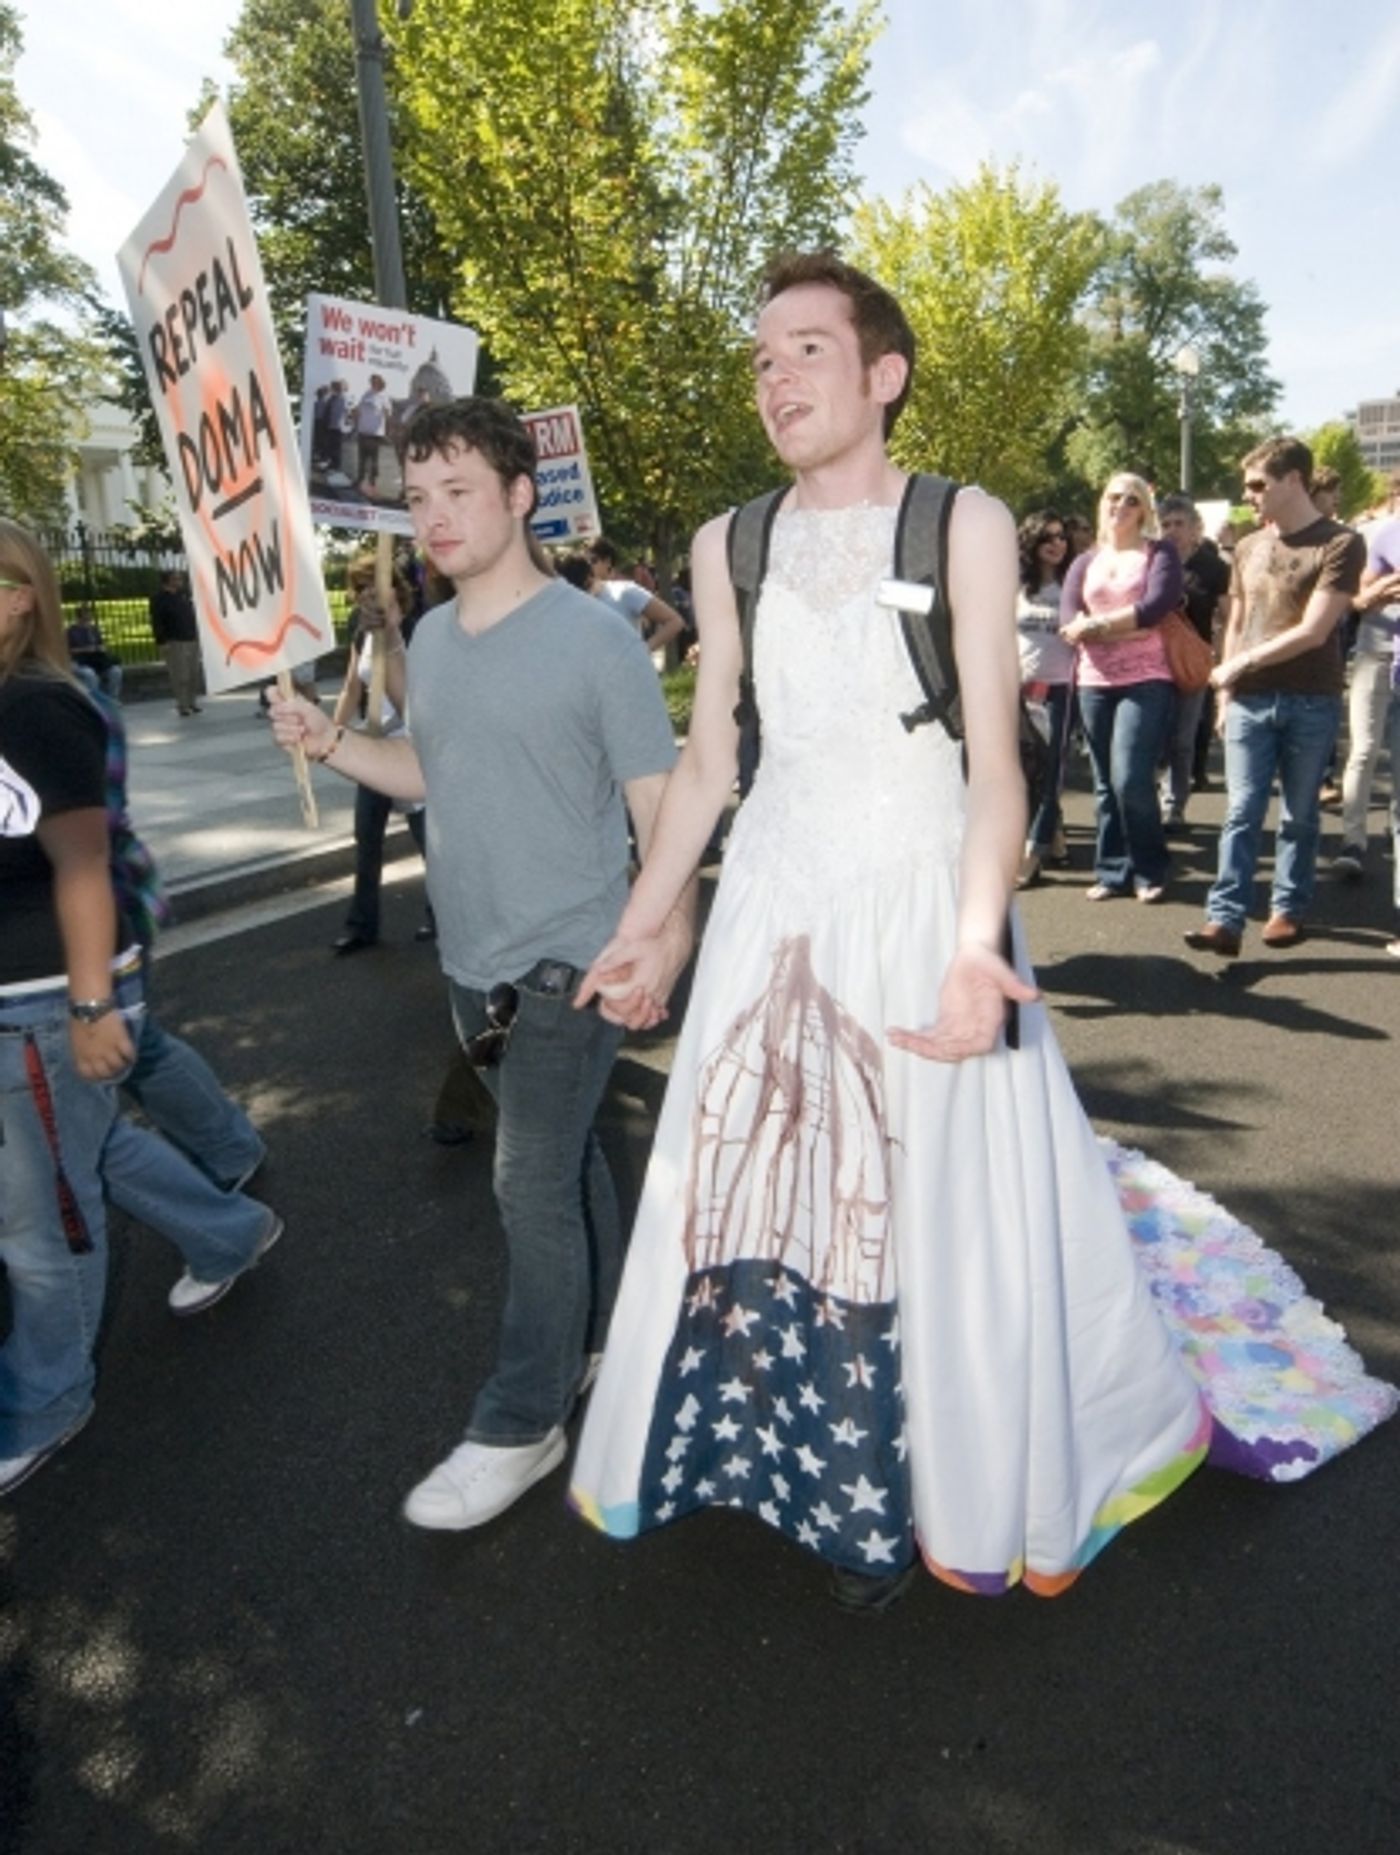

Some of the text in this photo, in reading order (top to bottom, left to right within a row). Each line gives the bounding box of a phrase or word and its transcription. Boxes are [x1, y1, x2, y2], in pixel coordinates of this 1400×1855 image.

[148, 236, 254, 395] REPEAL
[318, 337, 367, 363] wait
[321, 304, 417, 348] We won't
[176, 369, 278, 514] DOMA
[530, 414, 578, 458] RM
[213, 520, 286, 619] NOW
